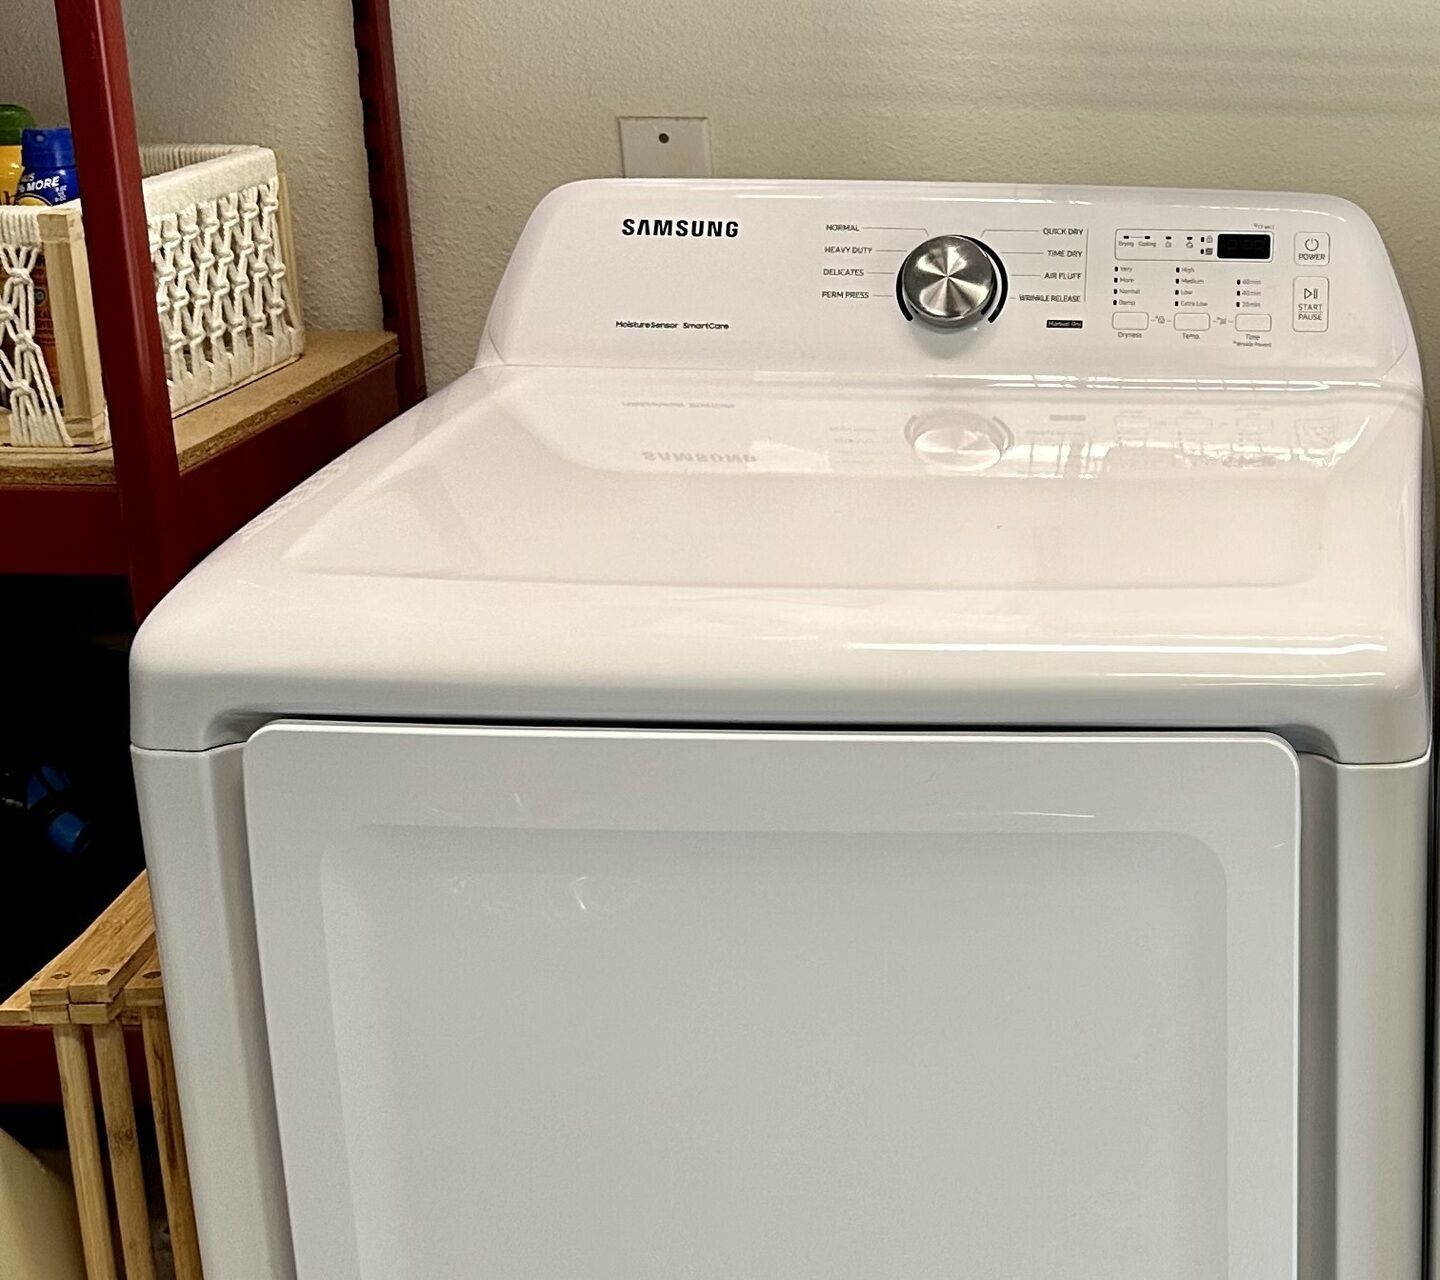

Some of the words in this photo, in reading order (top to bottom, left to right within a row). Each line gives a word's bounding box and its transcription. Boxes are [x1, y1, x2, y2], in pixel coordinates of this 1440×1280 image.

[26, 175, 60, 191] MORE
[621, 218, 740, 238] SAMSUNG
[825, 224, 860, 232] NORMAL
[1042, 227, 1067, 235] QUICK
[1067, 227, 1084, 236] DRY
[824, 246, 851, 254] HEAVY
[852, 246, 872, 254] DUTY
[1047, 249, 1066, 258] TIME
[1067, 250, 1083, 258] DRY
[823, 268, 864, 276] DELICATES
[1044, 272, 1057, 280] AIR
[1058, 272, 1082, 280] FLUFF
[821, 291, 844, 299] PERM
[845, 291, 869, 299] PRESS
[1018, 294, 1049, 302] WRINKLE
[1050, 295, 1081, 303] RELEASE
[1298, 303, 1323, 311] START
[1297, 313, 1322, 321] PAUSE
[1245, 333, 1260, 341] Time
